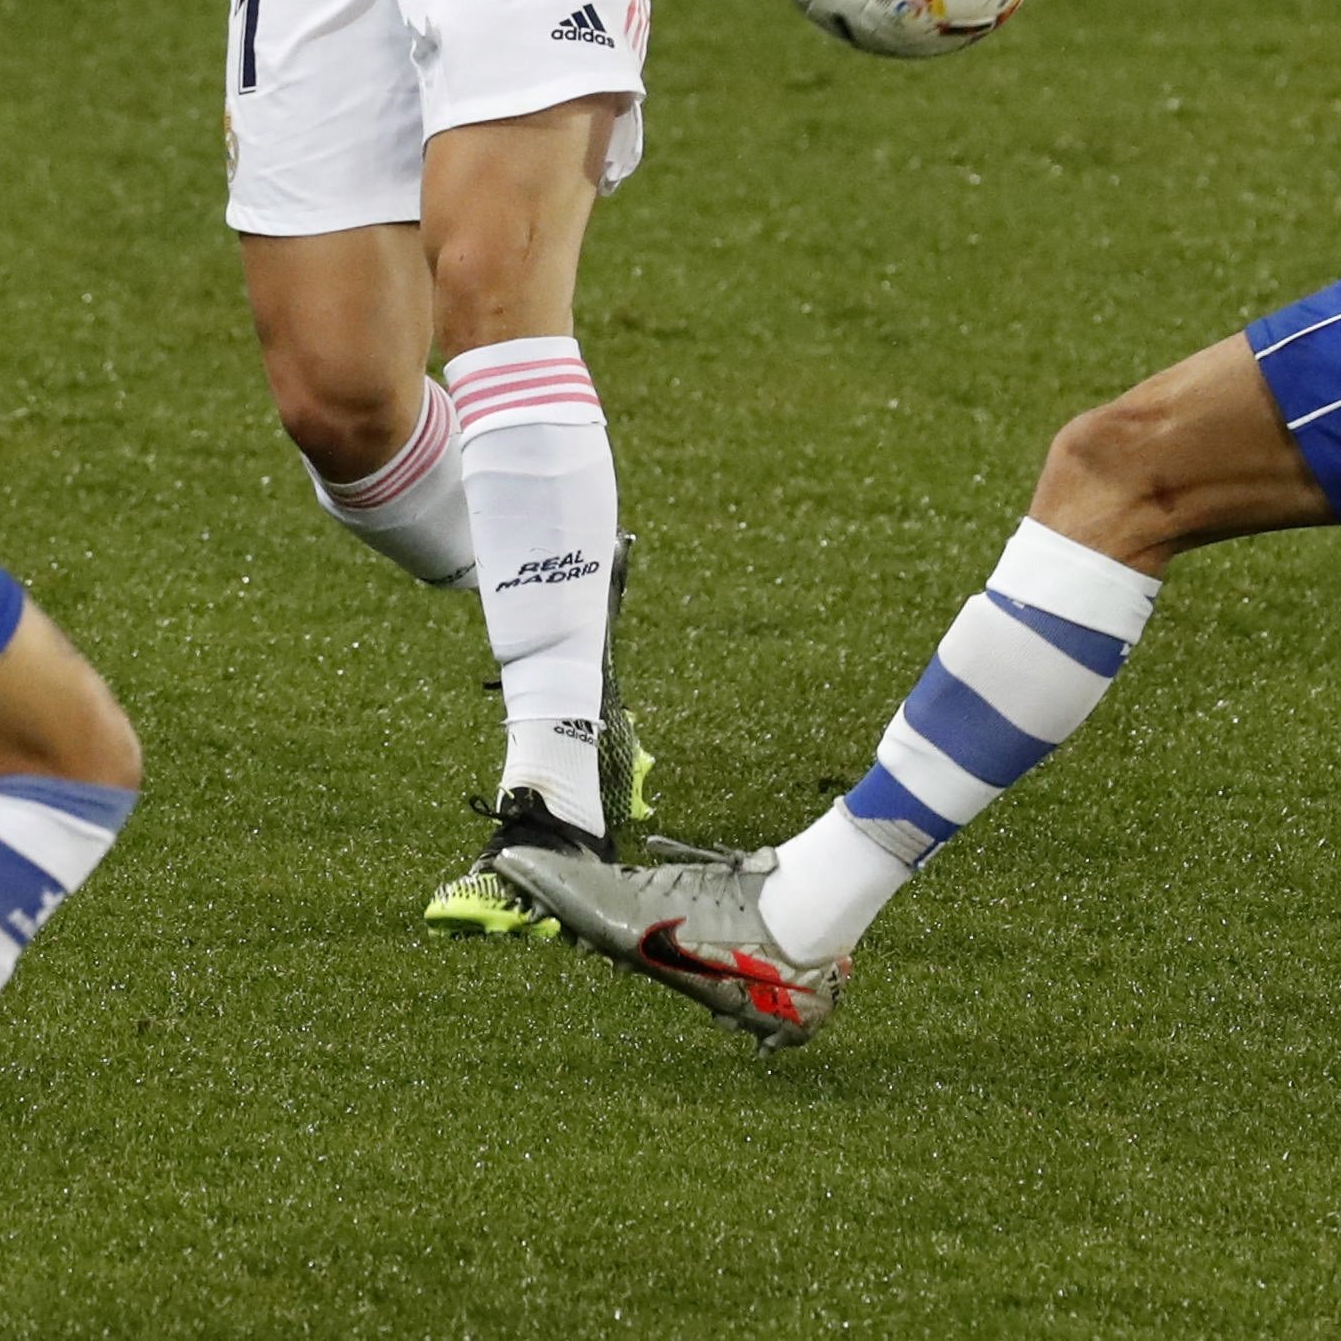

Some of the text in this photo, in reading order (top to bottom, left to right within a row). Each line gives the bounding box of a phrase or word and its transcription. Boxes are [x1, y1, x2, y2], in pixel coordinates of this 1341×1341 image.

[551, 25, 616, 49] adidas
[517, 549, 585, 576] REAL
[495, 561, 600, 593] MADRID
[553, 725, 596, 746] adida
